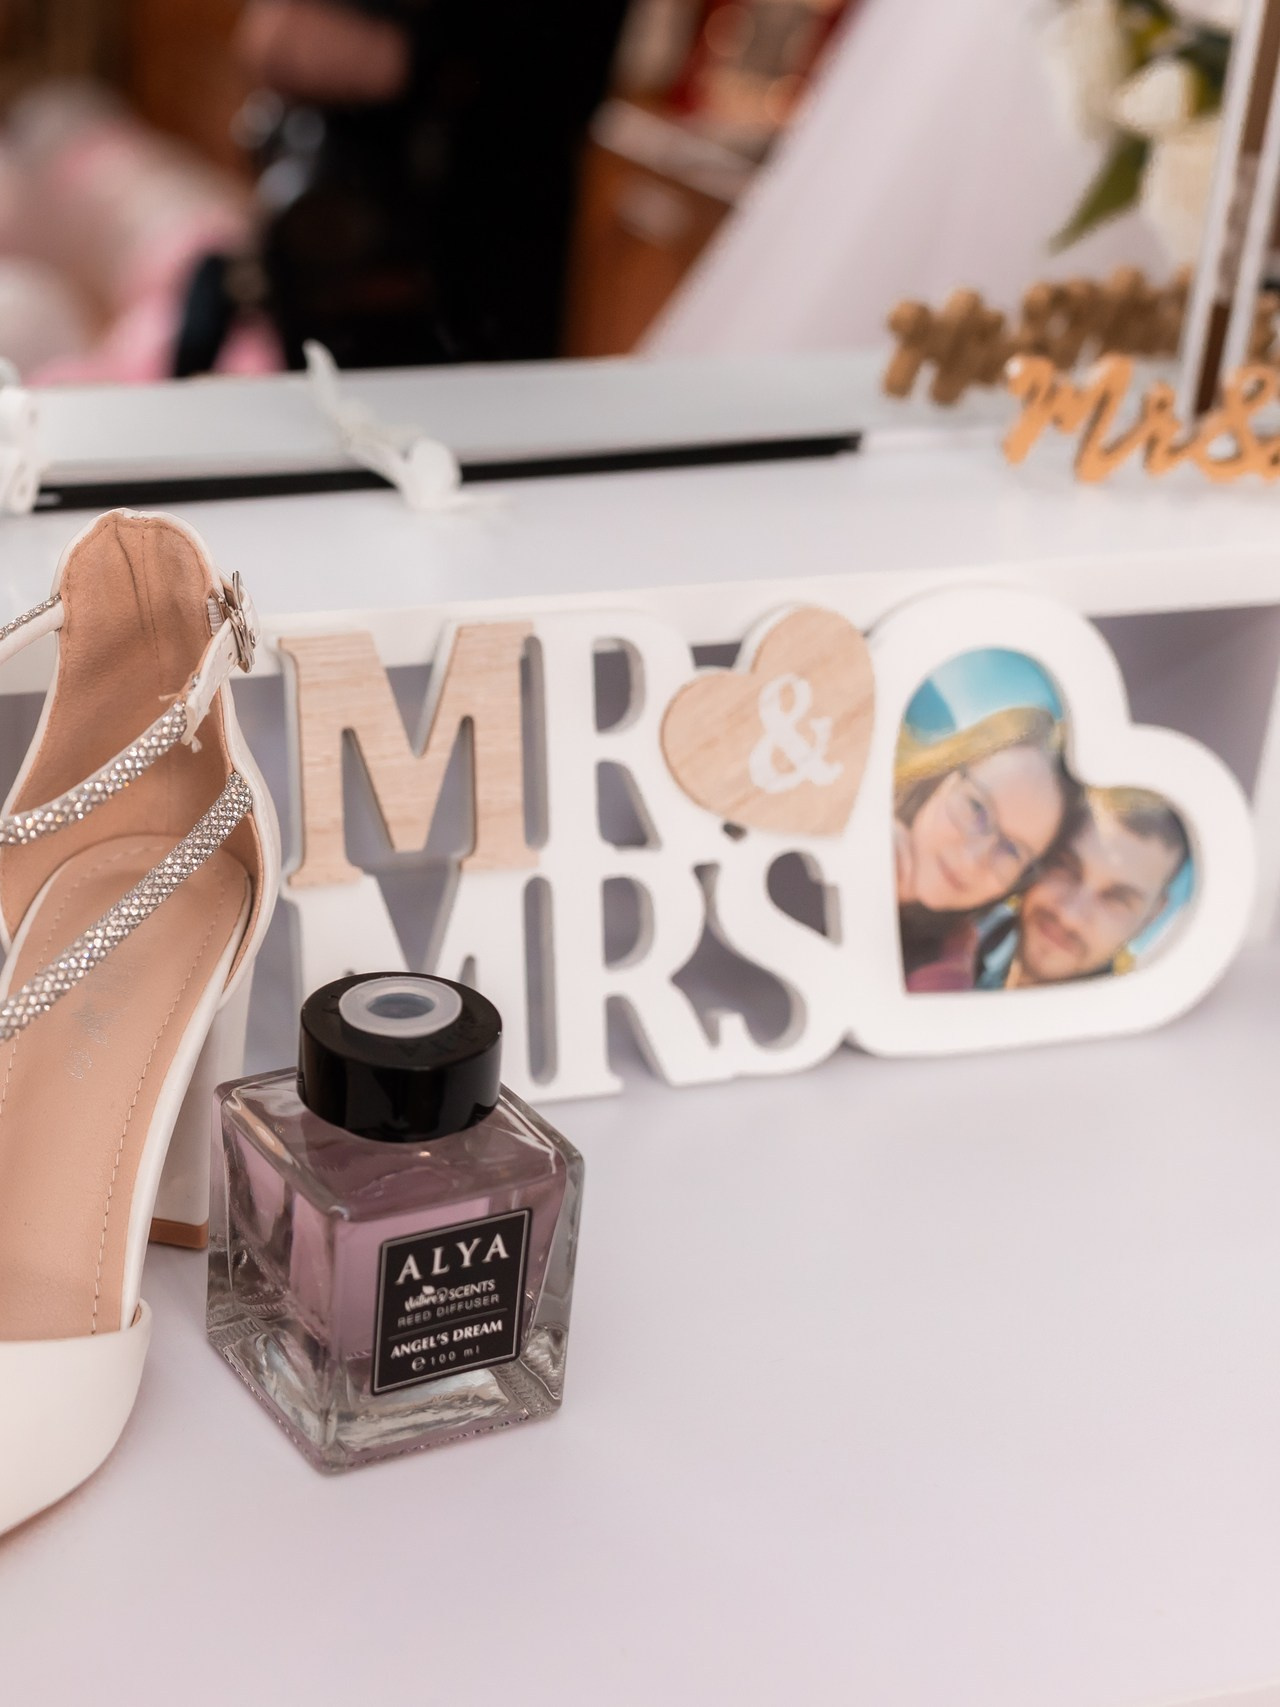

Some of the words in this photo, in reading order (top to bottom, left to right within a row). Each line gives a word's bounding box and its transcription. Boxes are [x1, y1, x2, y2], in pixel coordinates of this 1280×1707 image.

[277, 608, 692, 890] MR
[748, 672, 843, 795] &
[395, 1233, 510, 1285] ALYA
[448, 1279, 496, 1301] SCENTS
[397, 1310, 432, 1328] REED
[436, 1294, 500, 1318] DIFFUSER
[390, 1332, 449, 1359] ANGEL'S
[452, 1319, 503, 1342] DREAM
